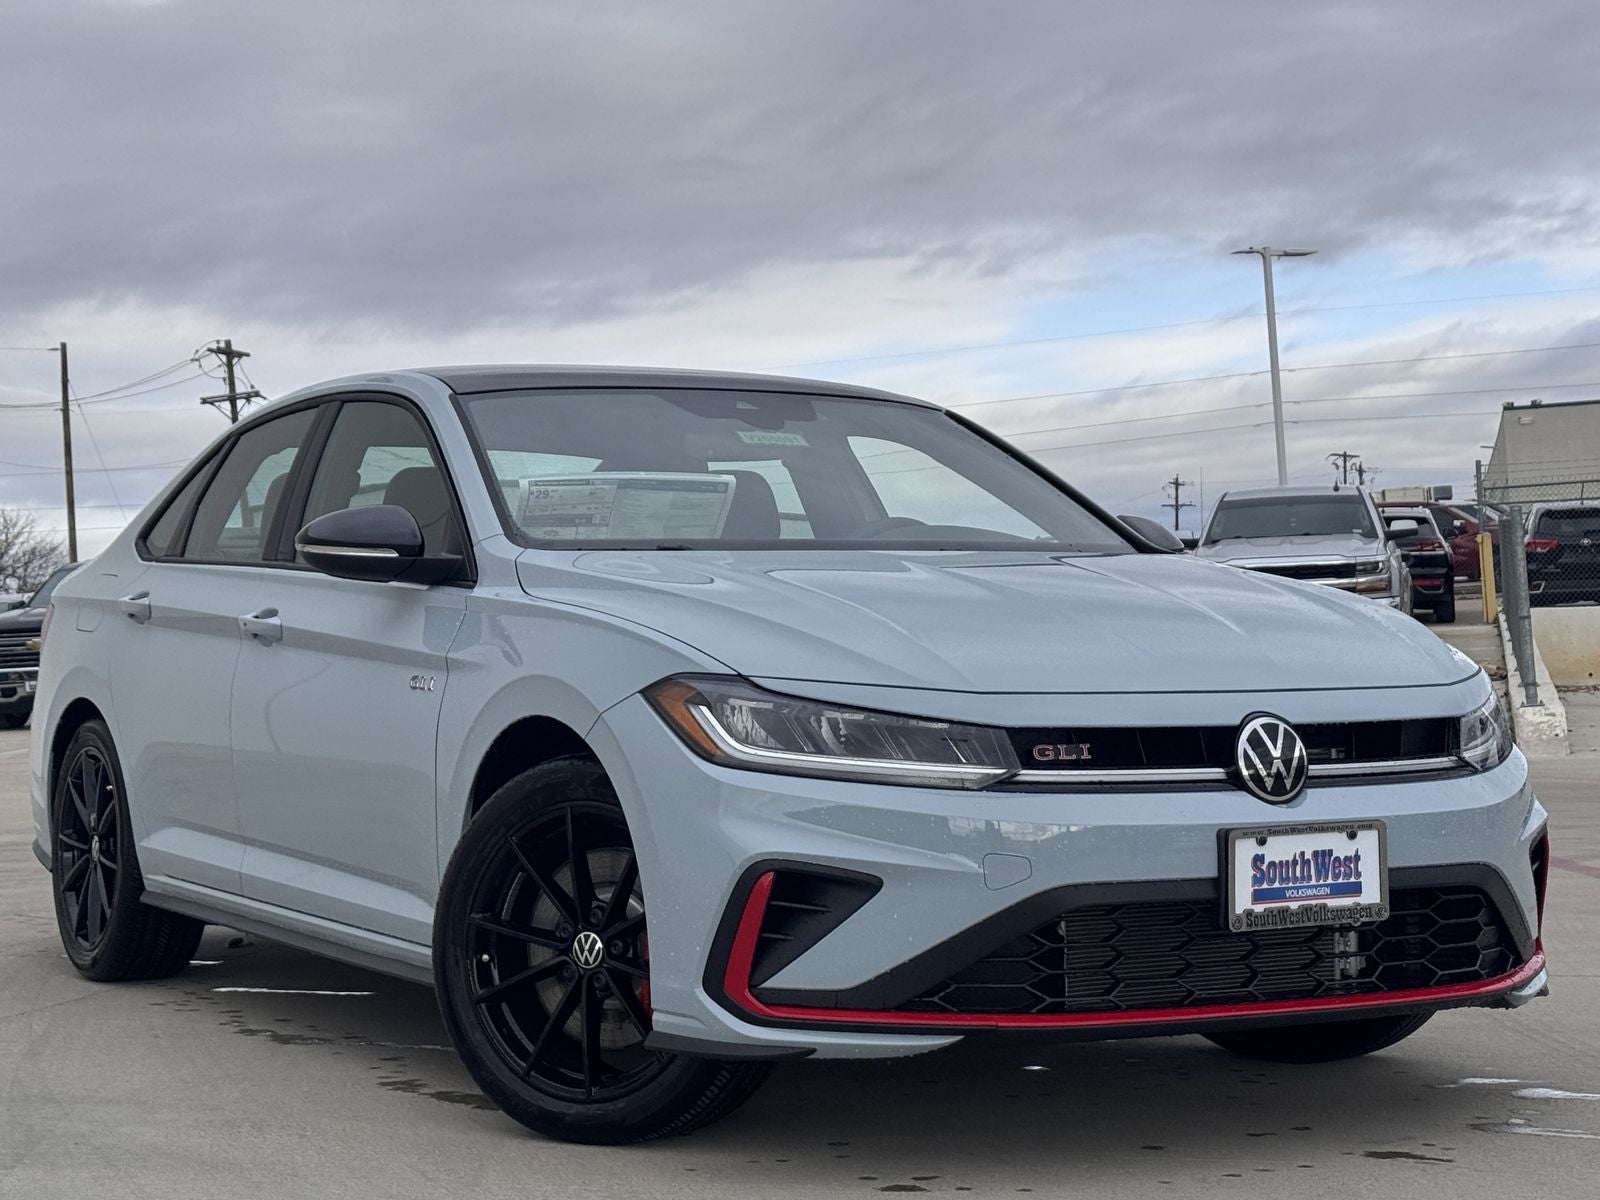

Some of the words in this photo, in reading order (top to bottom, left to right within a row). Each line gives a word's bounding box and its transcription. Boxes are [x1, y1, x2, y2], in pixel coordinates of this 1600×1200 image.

[535, 489, 550, 499] 29
[1033, 743, 1092, 761] GLI
[1251, 848, 1363, 887] SouthWest
[1285, 886, 1331, 899] VOLKSWAGEN
